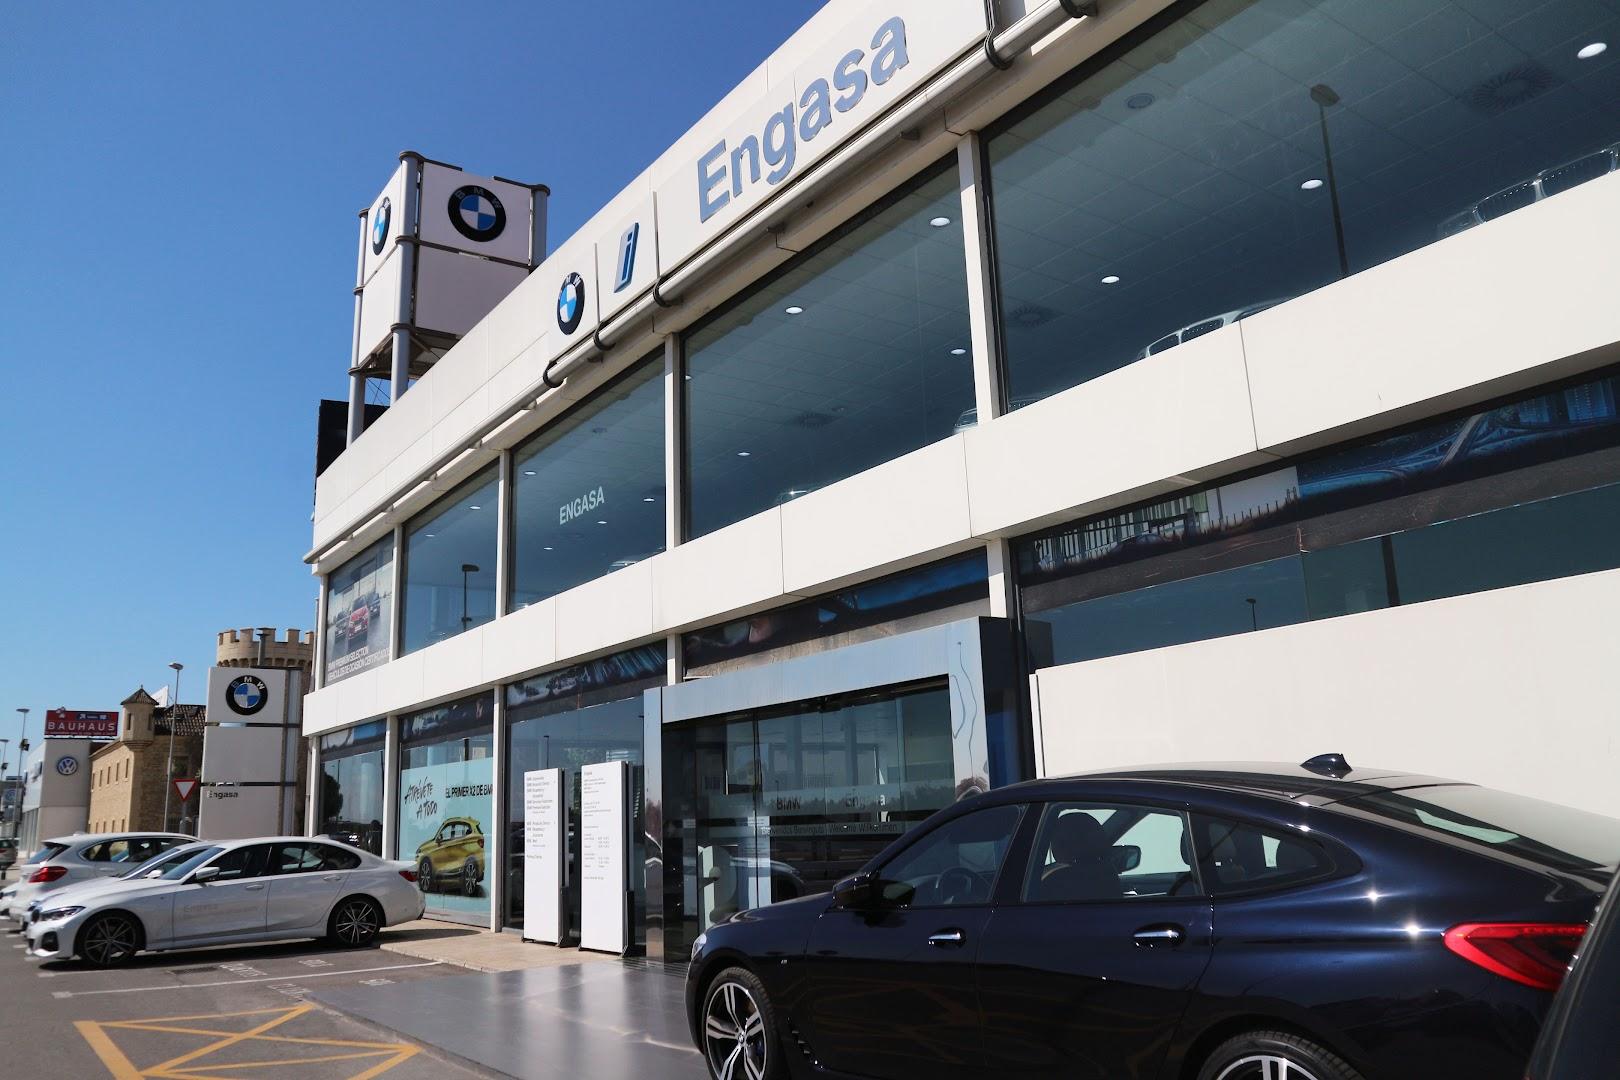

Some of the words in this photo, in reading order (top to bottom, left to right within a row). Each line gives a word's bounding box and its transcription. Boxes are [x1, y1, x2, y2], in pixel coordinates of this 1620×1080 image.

[697, 16, 909, 223] Engasa
[560, 486, 605, 525] ENGASA
[47, 721, 115, 731] BAUHAUS
[207, 790, 239, 800] Engasa
[451, 786, 469, 798] PRIMER
[777, 796, 800, 810] BMW
[858, 821, 898, 833] Willkmmen
